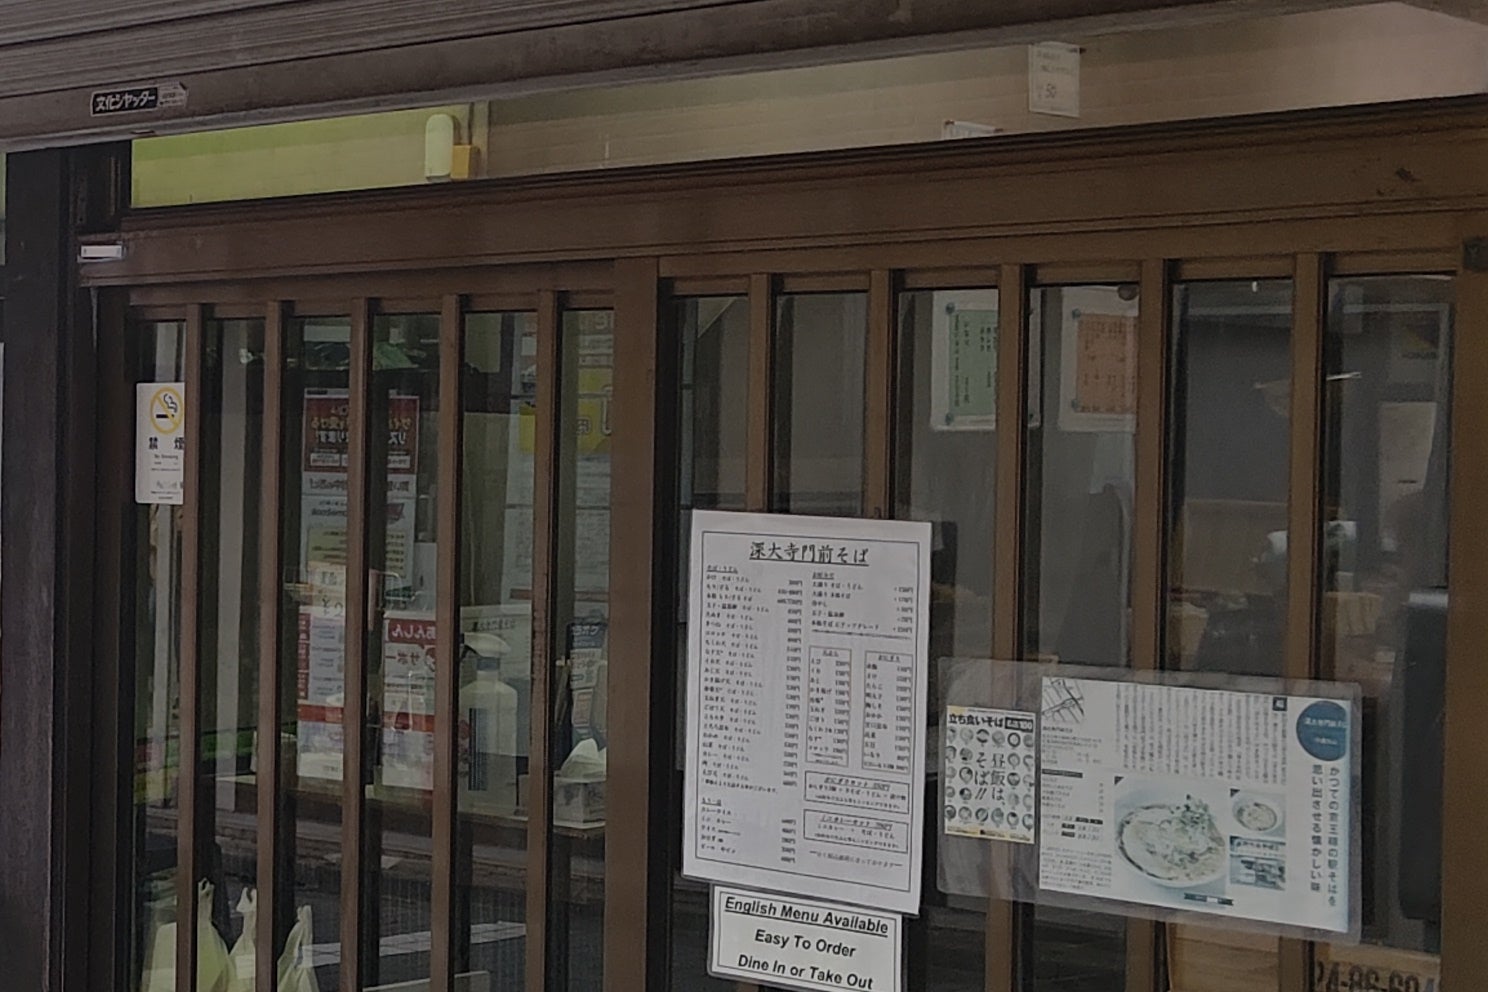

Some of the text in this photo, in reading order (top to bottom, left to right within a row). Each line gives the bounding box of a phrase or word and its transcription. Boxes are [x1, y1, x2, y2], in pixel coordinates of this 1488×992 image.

[95, 90, 156, 111] 文化シャッター
[749, 541, 869, 565] 深大寺門前そば
[948, 713, 1004, 728] 立ち食いそば
[725, 896, 889, 934] English Menu Available
[755, 928, 857, 957] Easy To Order
[738, 954, 873, 990] Dine In or Take Out
